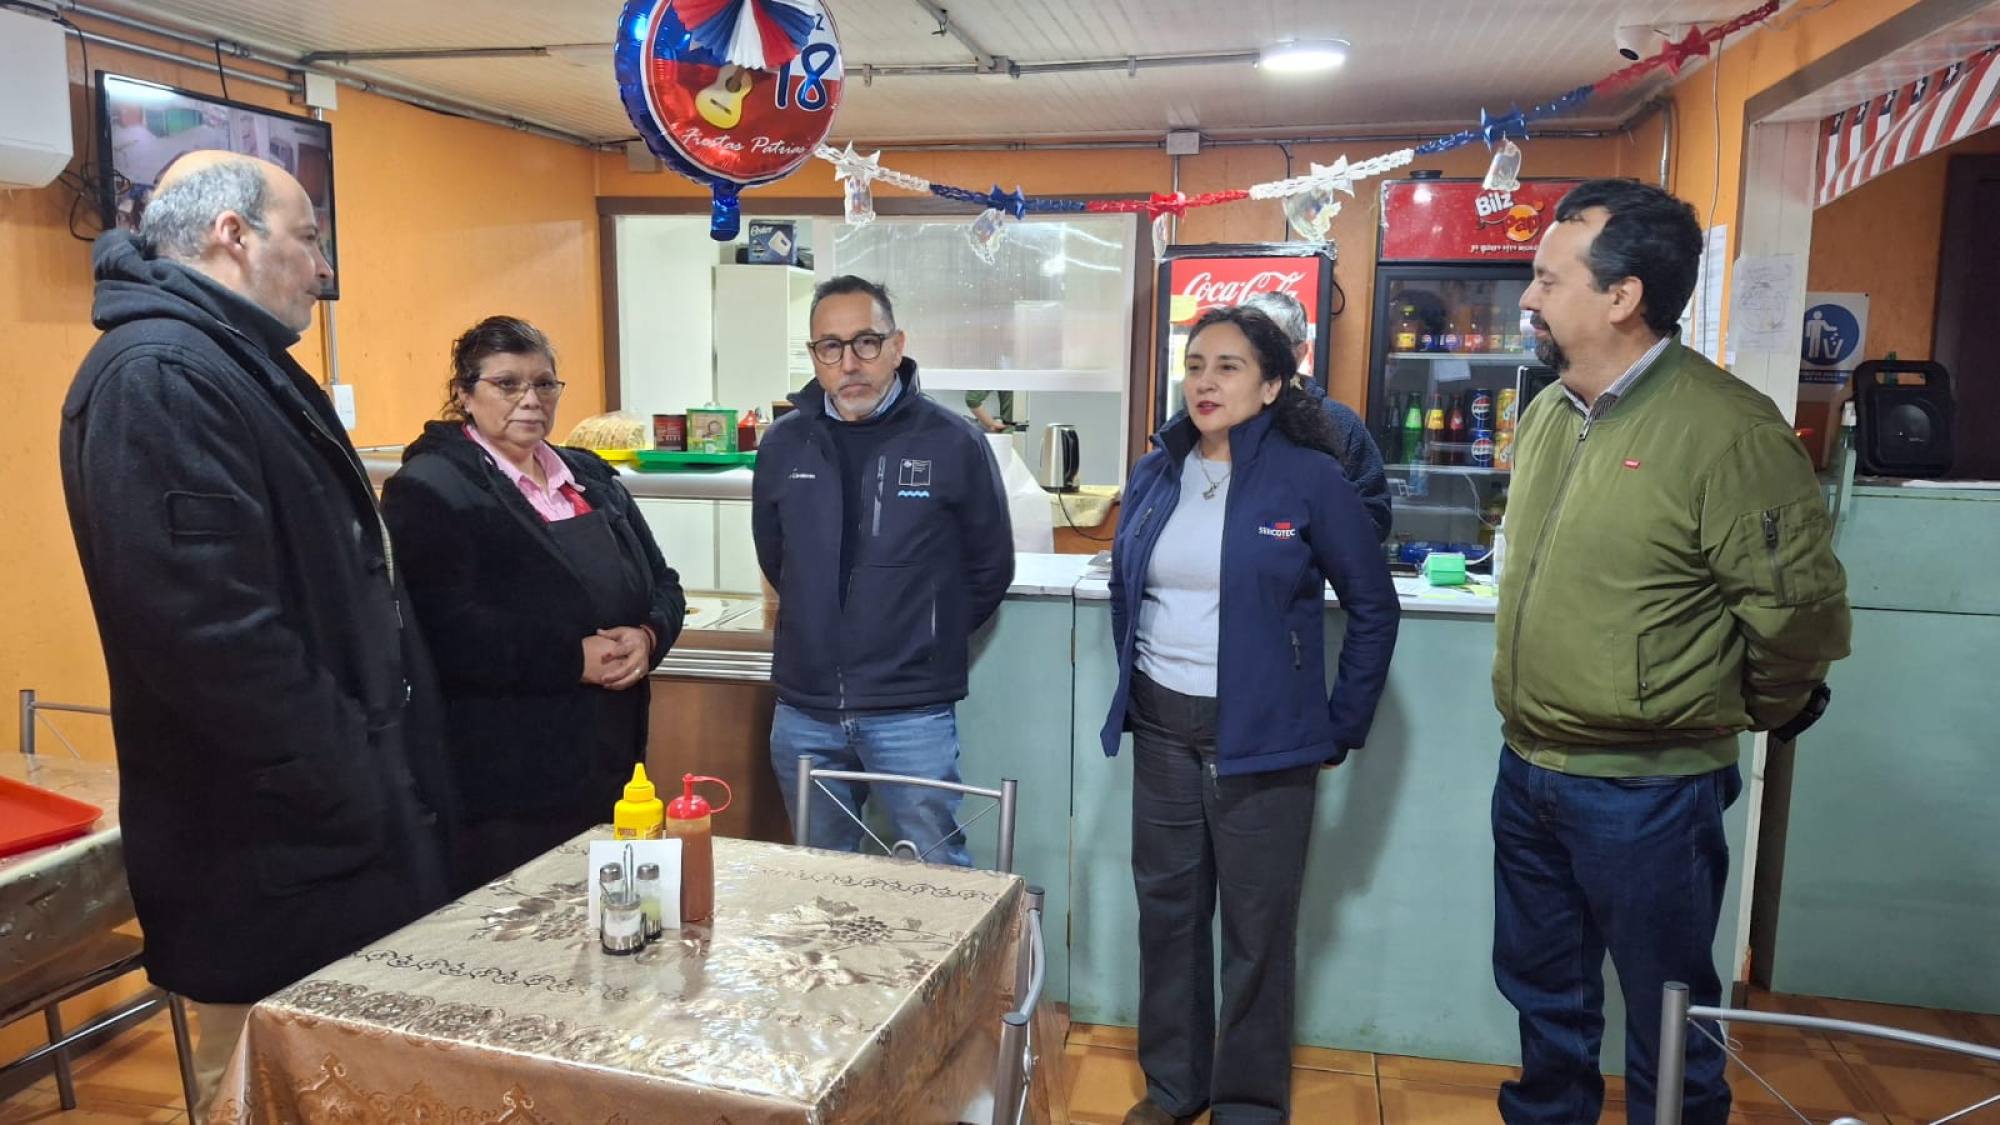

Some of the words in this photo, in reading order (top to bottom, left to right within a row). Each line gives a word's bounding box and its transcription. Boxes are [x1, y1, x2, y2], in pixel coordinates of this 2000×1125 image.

[776, 42, 837, 110] 18
[681, 127, 744, 151] Fiestas
[750, 136, 806, 155] Patrias
[1475, 191, 1514, 217] Bilz
